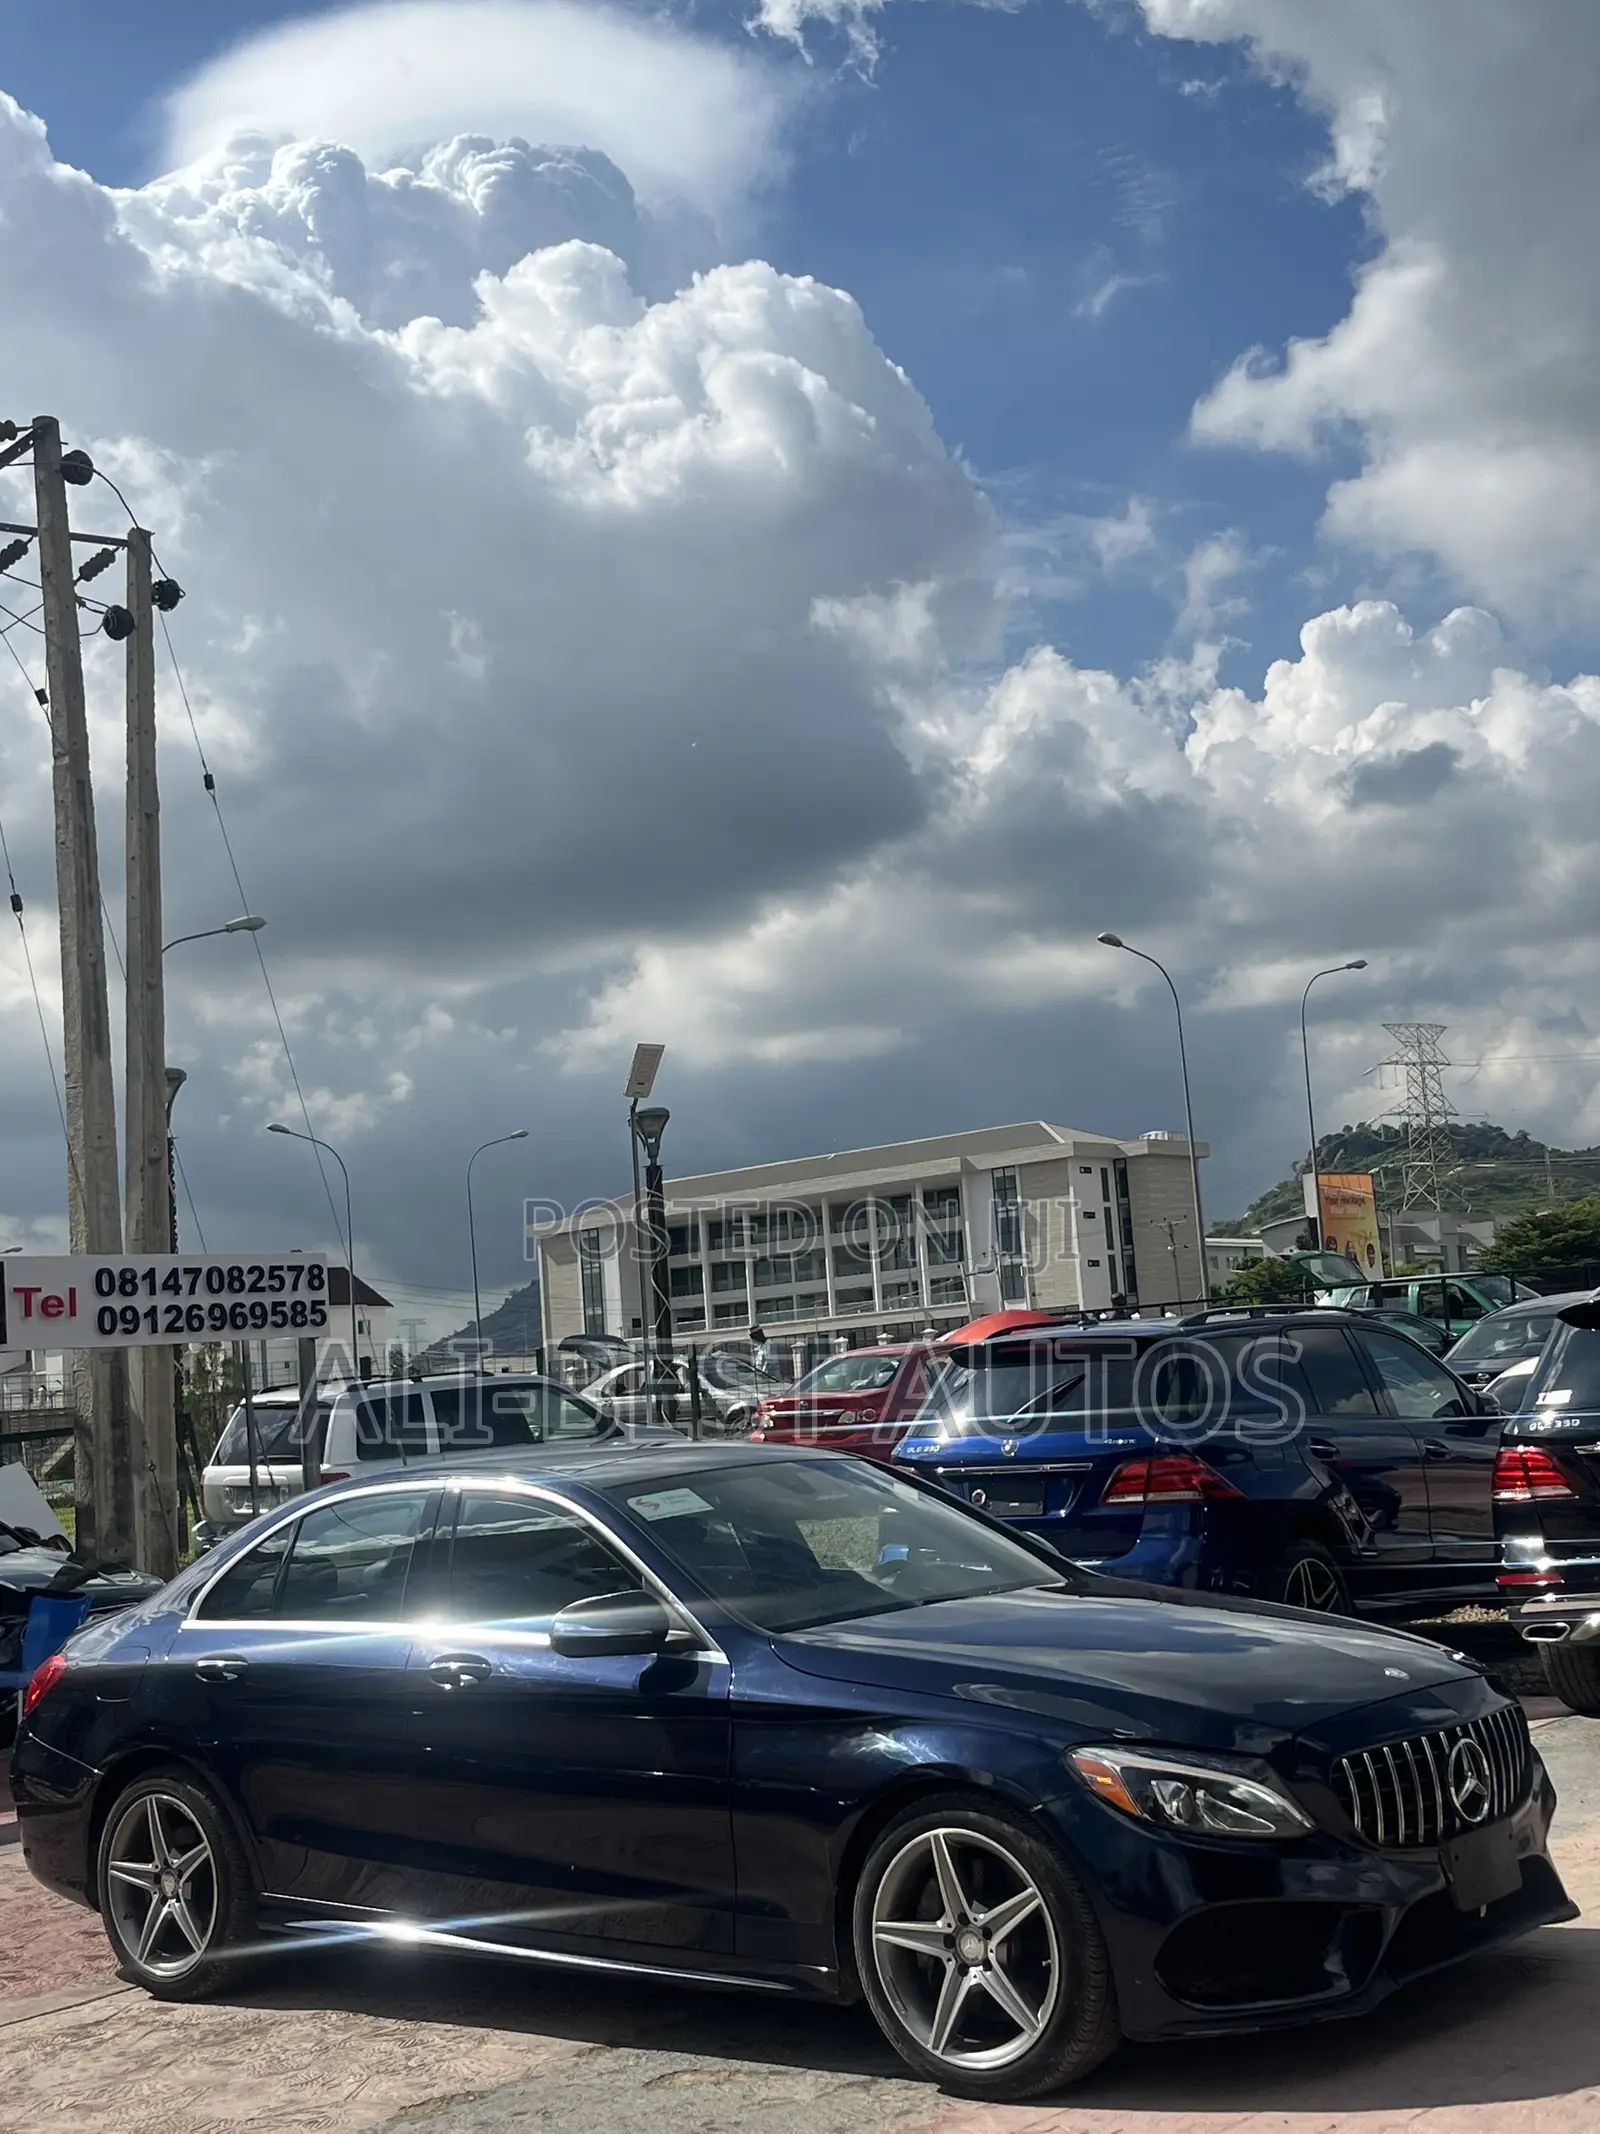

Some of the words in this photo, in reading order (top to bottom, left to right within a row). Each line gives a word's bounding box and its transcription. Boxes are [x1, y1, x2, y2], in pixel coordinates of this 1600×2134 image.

[95, 1263, 325, 1297] 08147082578
[13, 1287, 77, 1318] Tel
[97, 1300, 327, 1335] 09126969585
